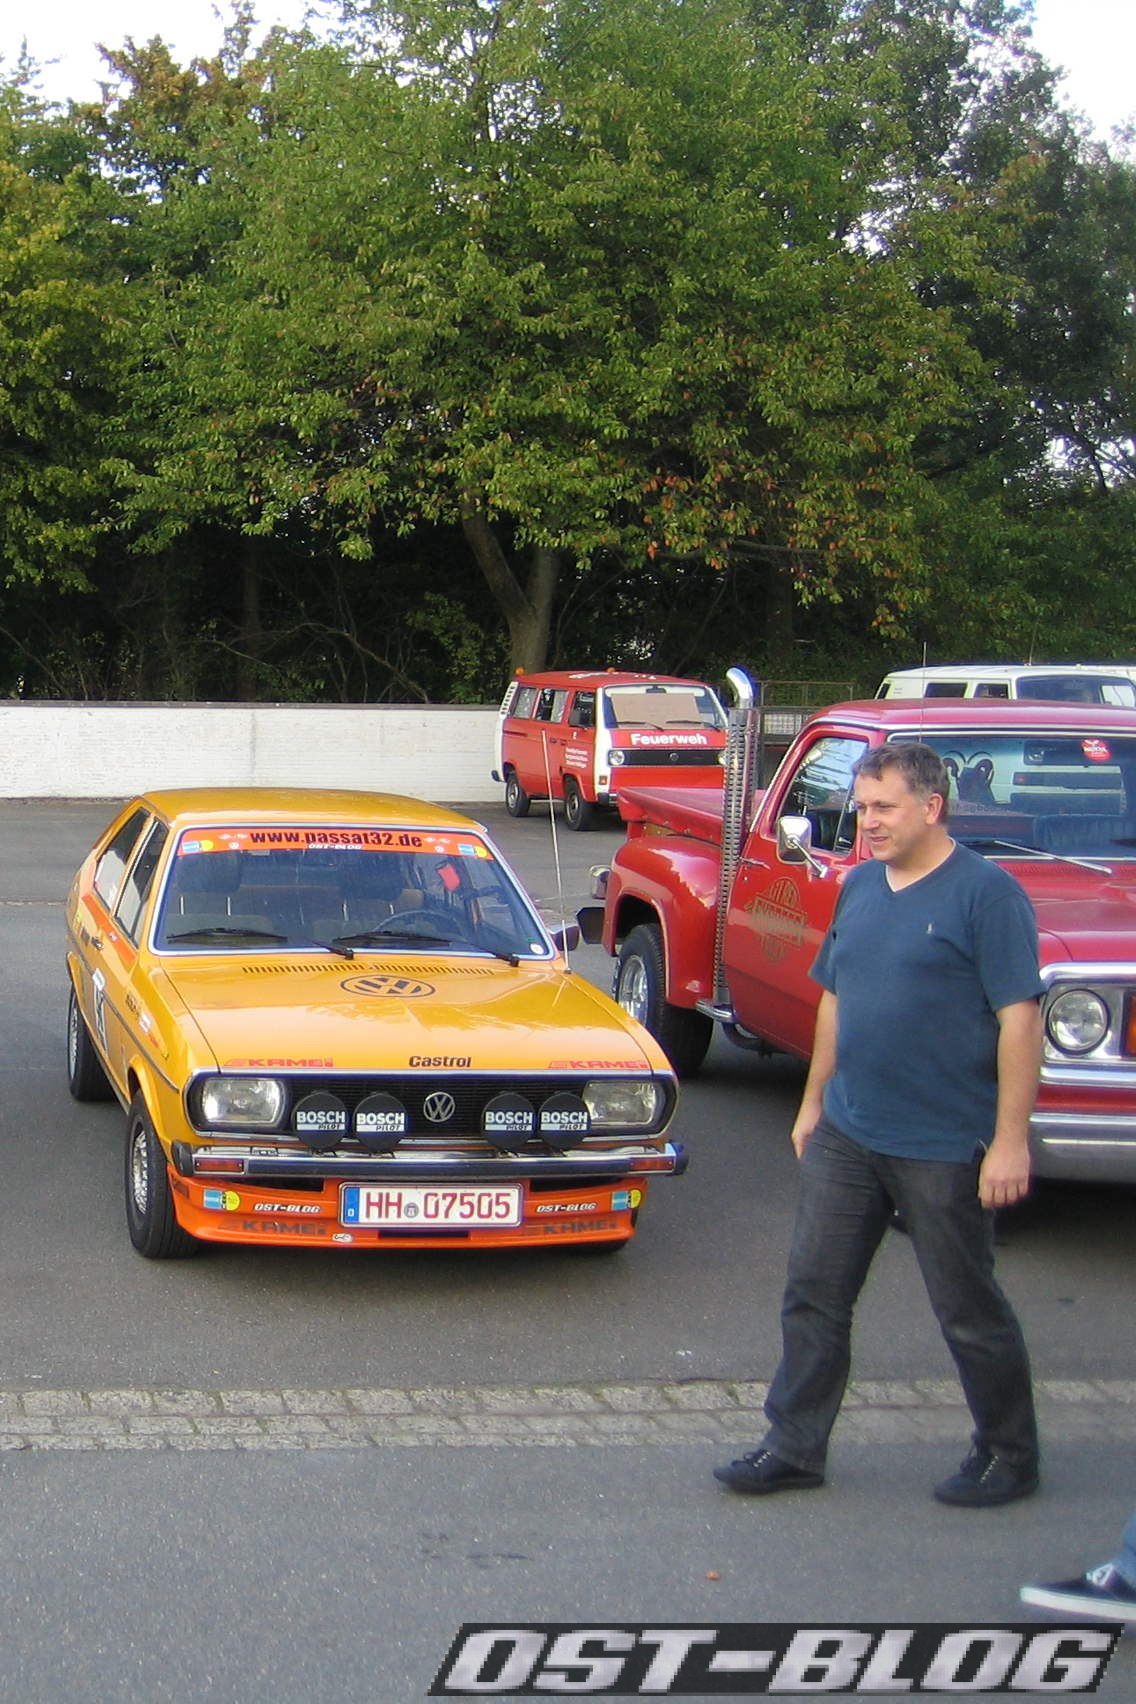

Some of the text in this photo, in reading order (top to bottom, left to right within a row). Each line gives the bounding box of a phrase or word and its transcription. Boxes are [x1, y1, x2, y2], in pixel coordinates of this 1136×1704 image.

[250, 832, 422, 847] www.passat32.de
[409, 1056, 471, 1068] Castrol
[296, 1111, 345, 1123] BOSCH
[357, 1112, 405, 1125] BOSCH
[485, 1111, 533, 1124] BOSCH
[541, 1111, 588, 1123] BOSCH
[254, 1203, 321, 1213] OST-BLOG
[365, 1192, 511, 1218] HH 07505
[536, 1202, 597, 1213] OST-BLOG
